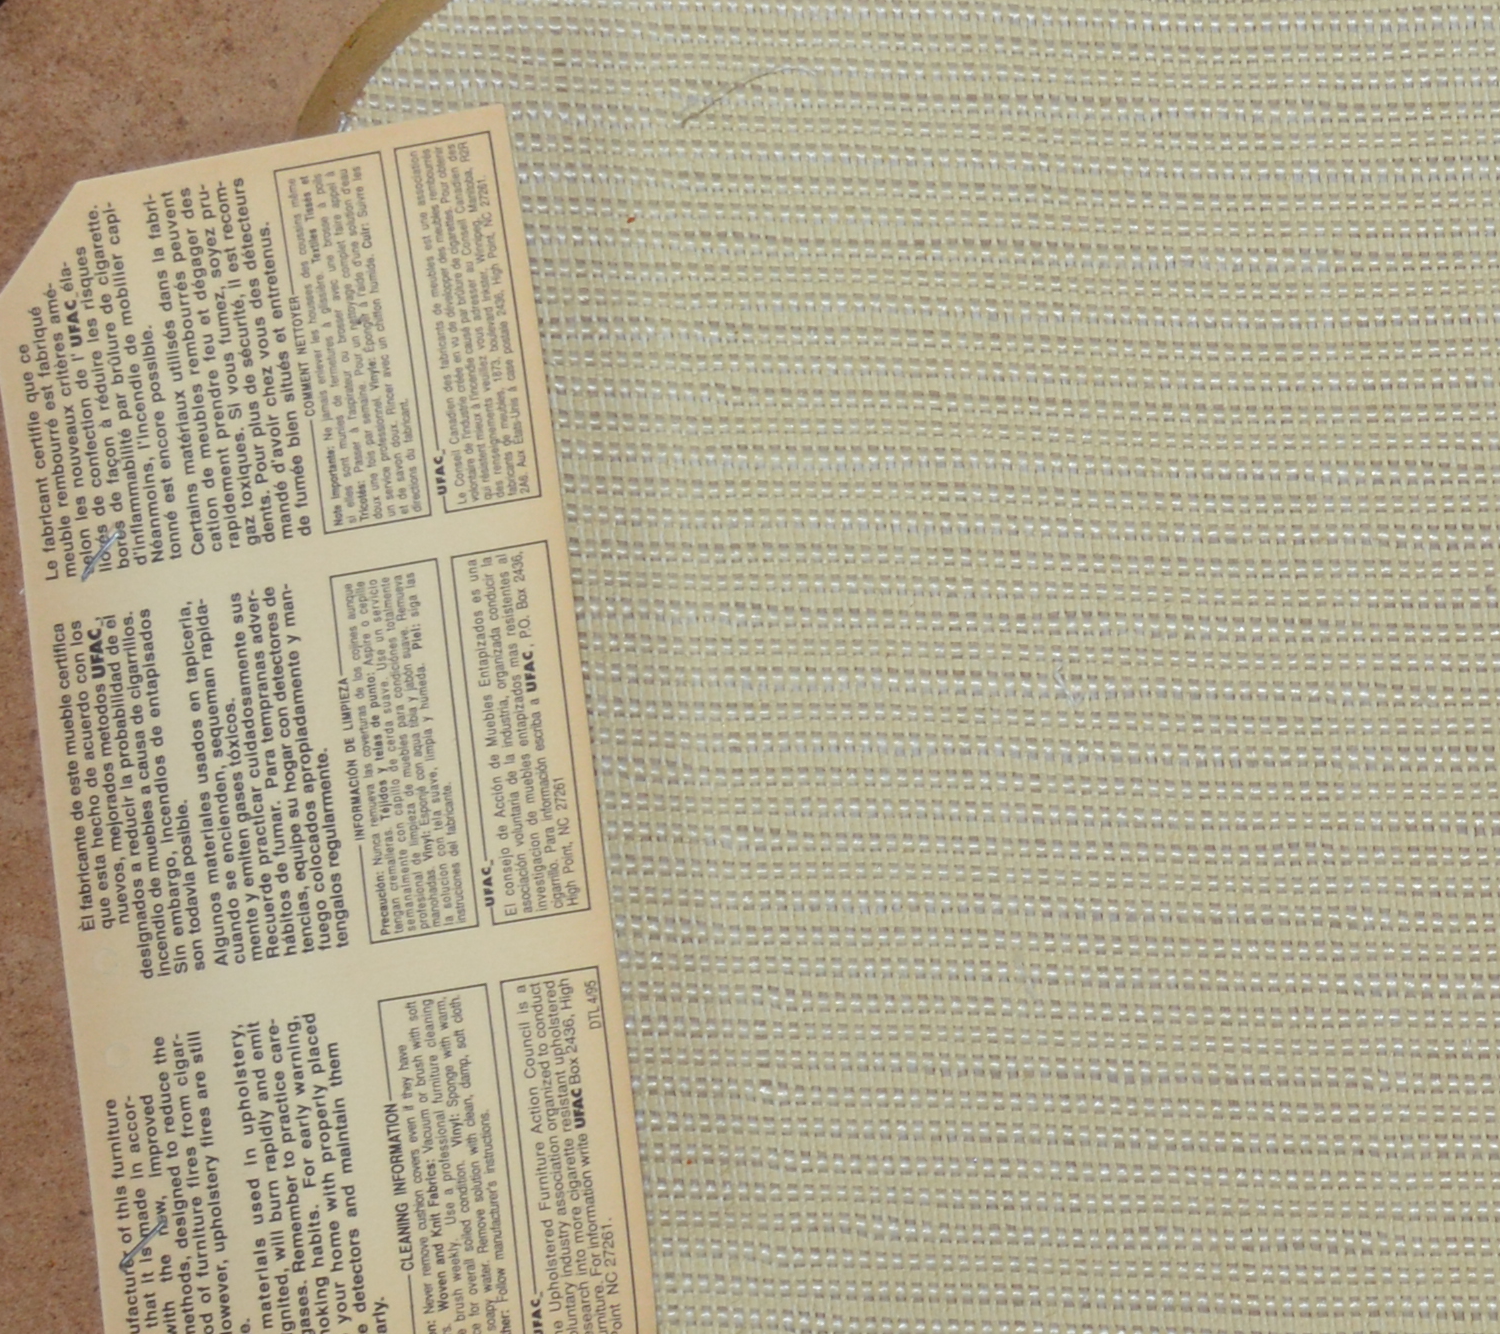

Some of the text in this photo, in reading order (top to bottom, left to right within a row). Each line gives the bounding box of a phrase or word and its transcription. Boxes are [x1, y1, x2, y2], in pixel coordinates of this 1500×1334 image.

[287, 294, 316, 417] COMMENT NETTOYER
[17, 343, 59, 581] Le fabricant certifie que ce
[26, 305, 77, 578] meuble rembourré est fabriqué
[51, 621, 71, 690] certifica
[57, 693, 77, 756] mueble
[65, 759, 82, 796] este
[68, 619, 117, 930] que esta hecho de acuerdo con los
[336, 676, 365, 841] INFORMACIÓN DE LIMPIEZA
[68, 799, 85, 821] de
[72, 824, 93, 911] fabricante
[582, 977, 604, 1031] DTL 4/95
[104, 1098, 125, 1180] furniture
[123, 1094, 141, 1153] accor-
[138, 1093, 163, 1178] improved
[128, 1161, 144, 1180] in
[382, 1102, 415, 1272] CLEANING INFORMATION
[112, 1184, 130, 1221] this
[130, 1185, 153, 1239] made
[116, 1225, 133, 1244] of
[136, 1245, 155, 1263] is
[139, 1270, 155, 1284] it
[157, 1253, 173, 1283] the
[142, 1291, 159, 1329] that
